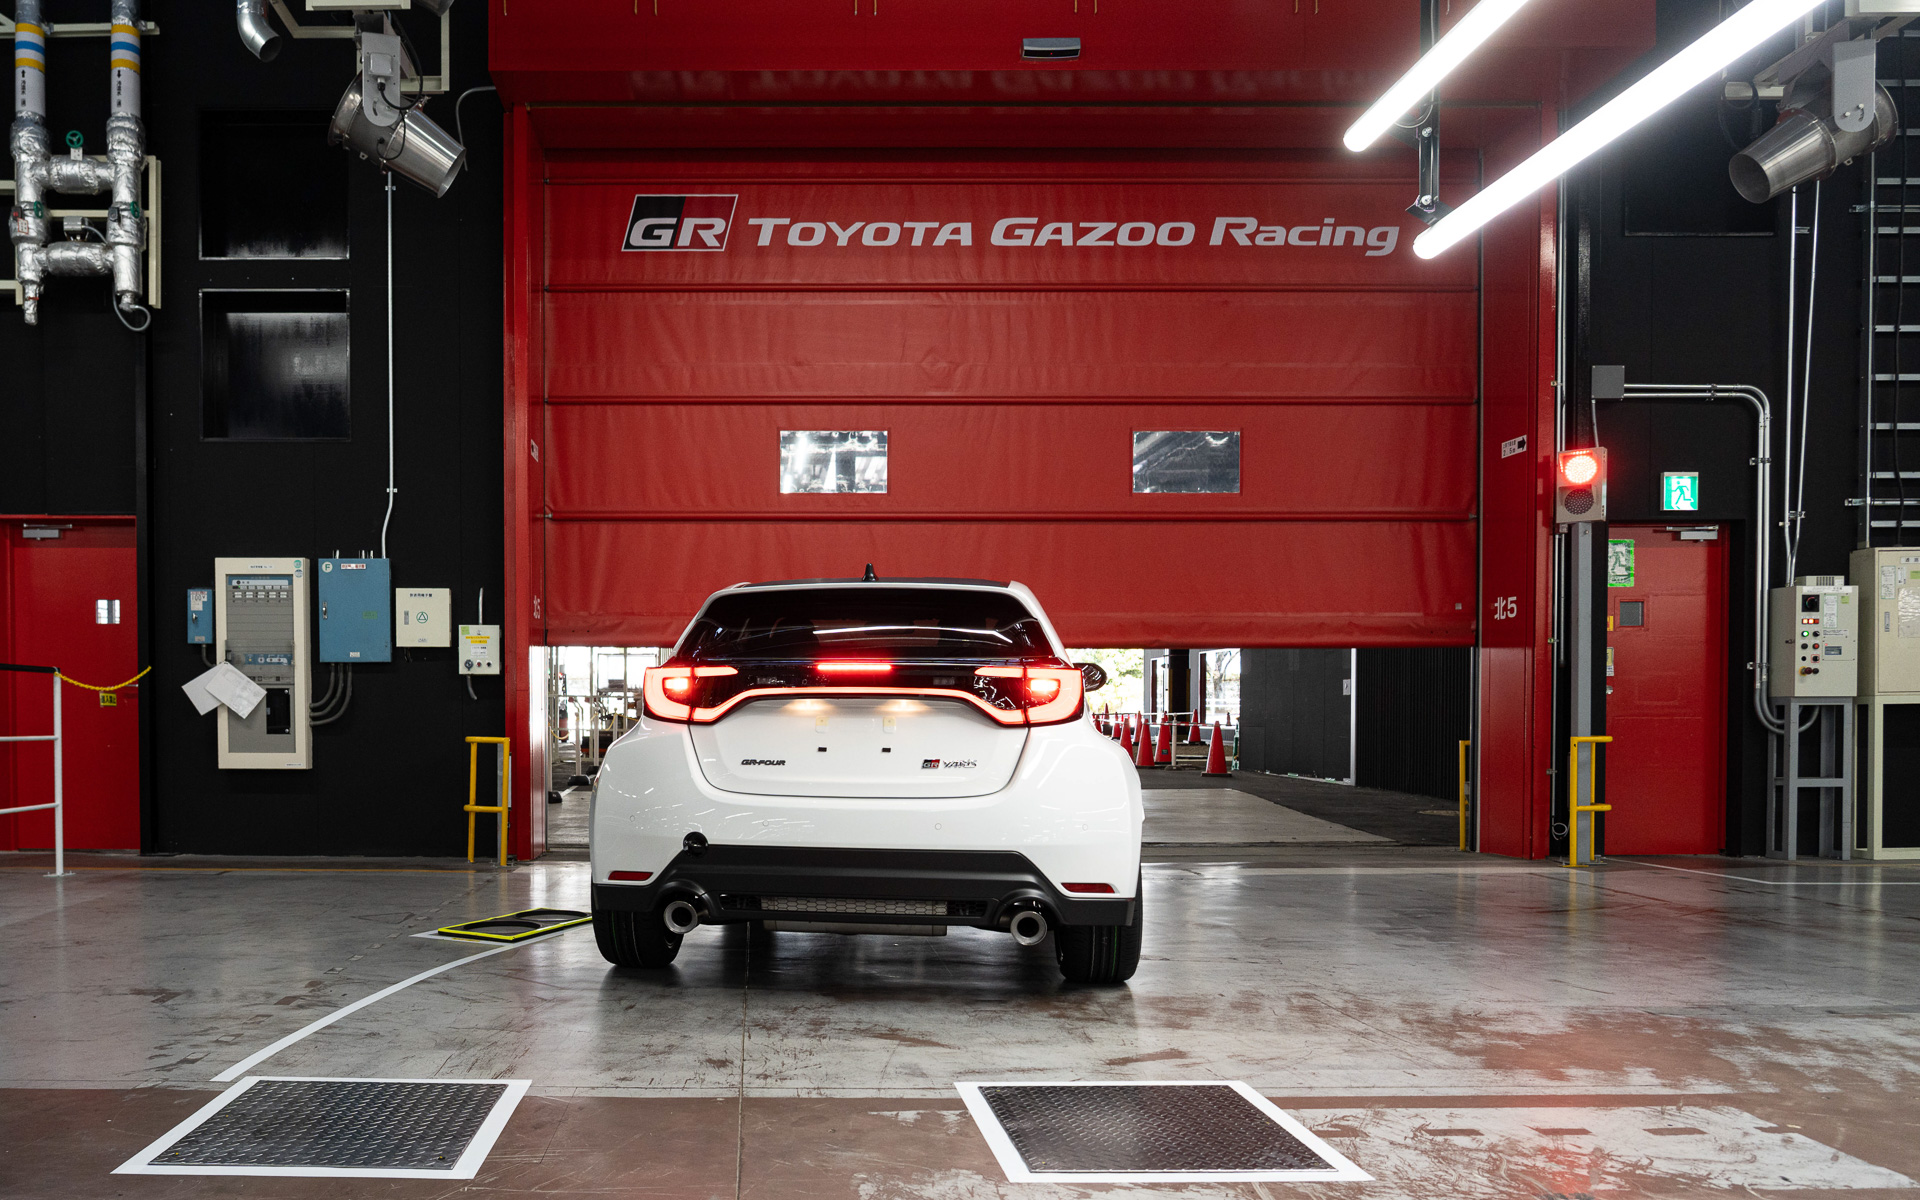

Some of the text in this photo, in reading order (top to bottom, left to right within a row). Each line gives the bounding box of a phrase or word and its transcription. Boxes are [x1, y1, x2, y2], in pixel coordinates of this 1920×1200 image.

[747, 217, 973, 247] TOYOTA
[989, 216, 1196, 247] GAZOO
[1208, 216, 1400, 257] Racing
[324, 563, 331, 571] F
[1494, 596, 1518, 621] 北5
[741, 758, 786, 766] GR-FOUR
[922, 761, 940, 769] GR
